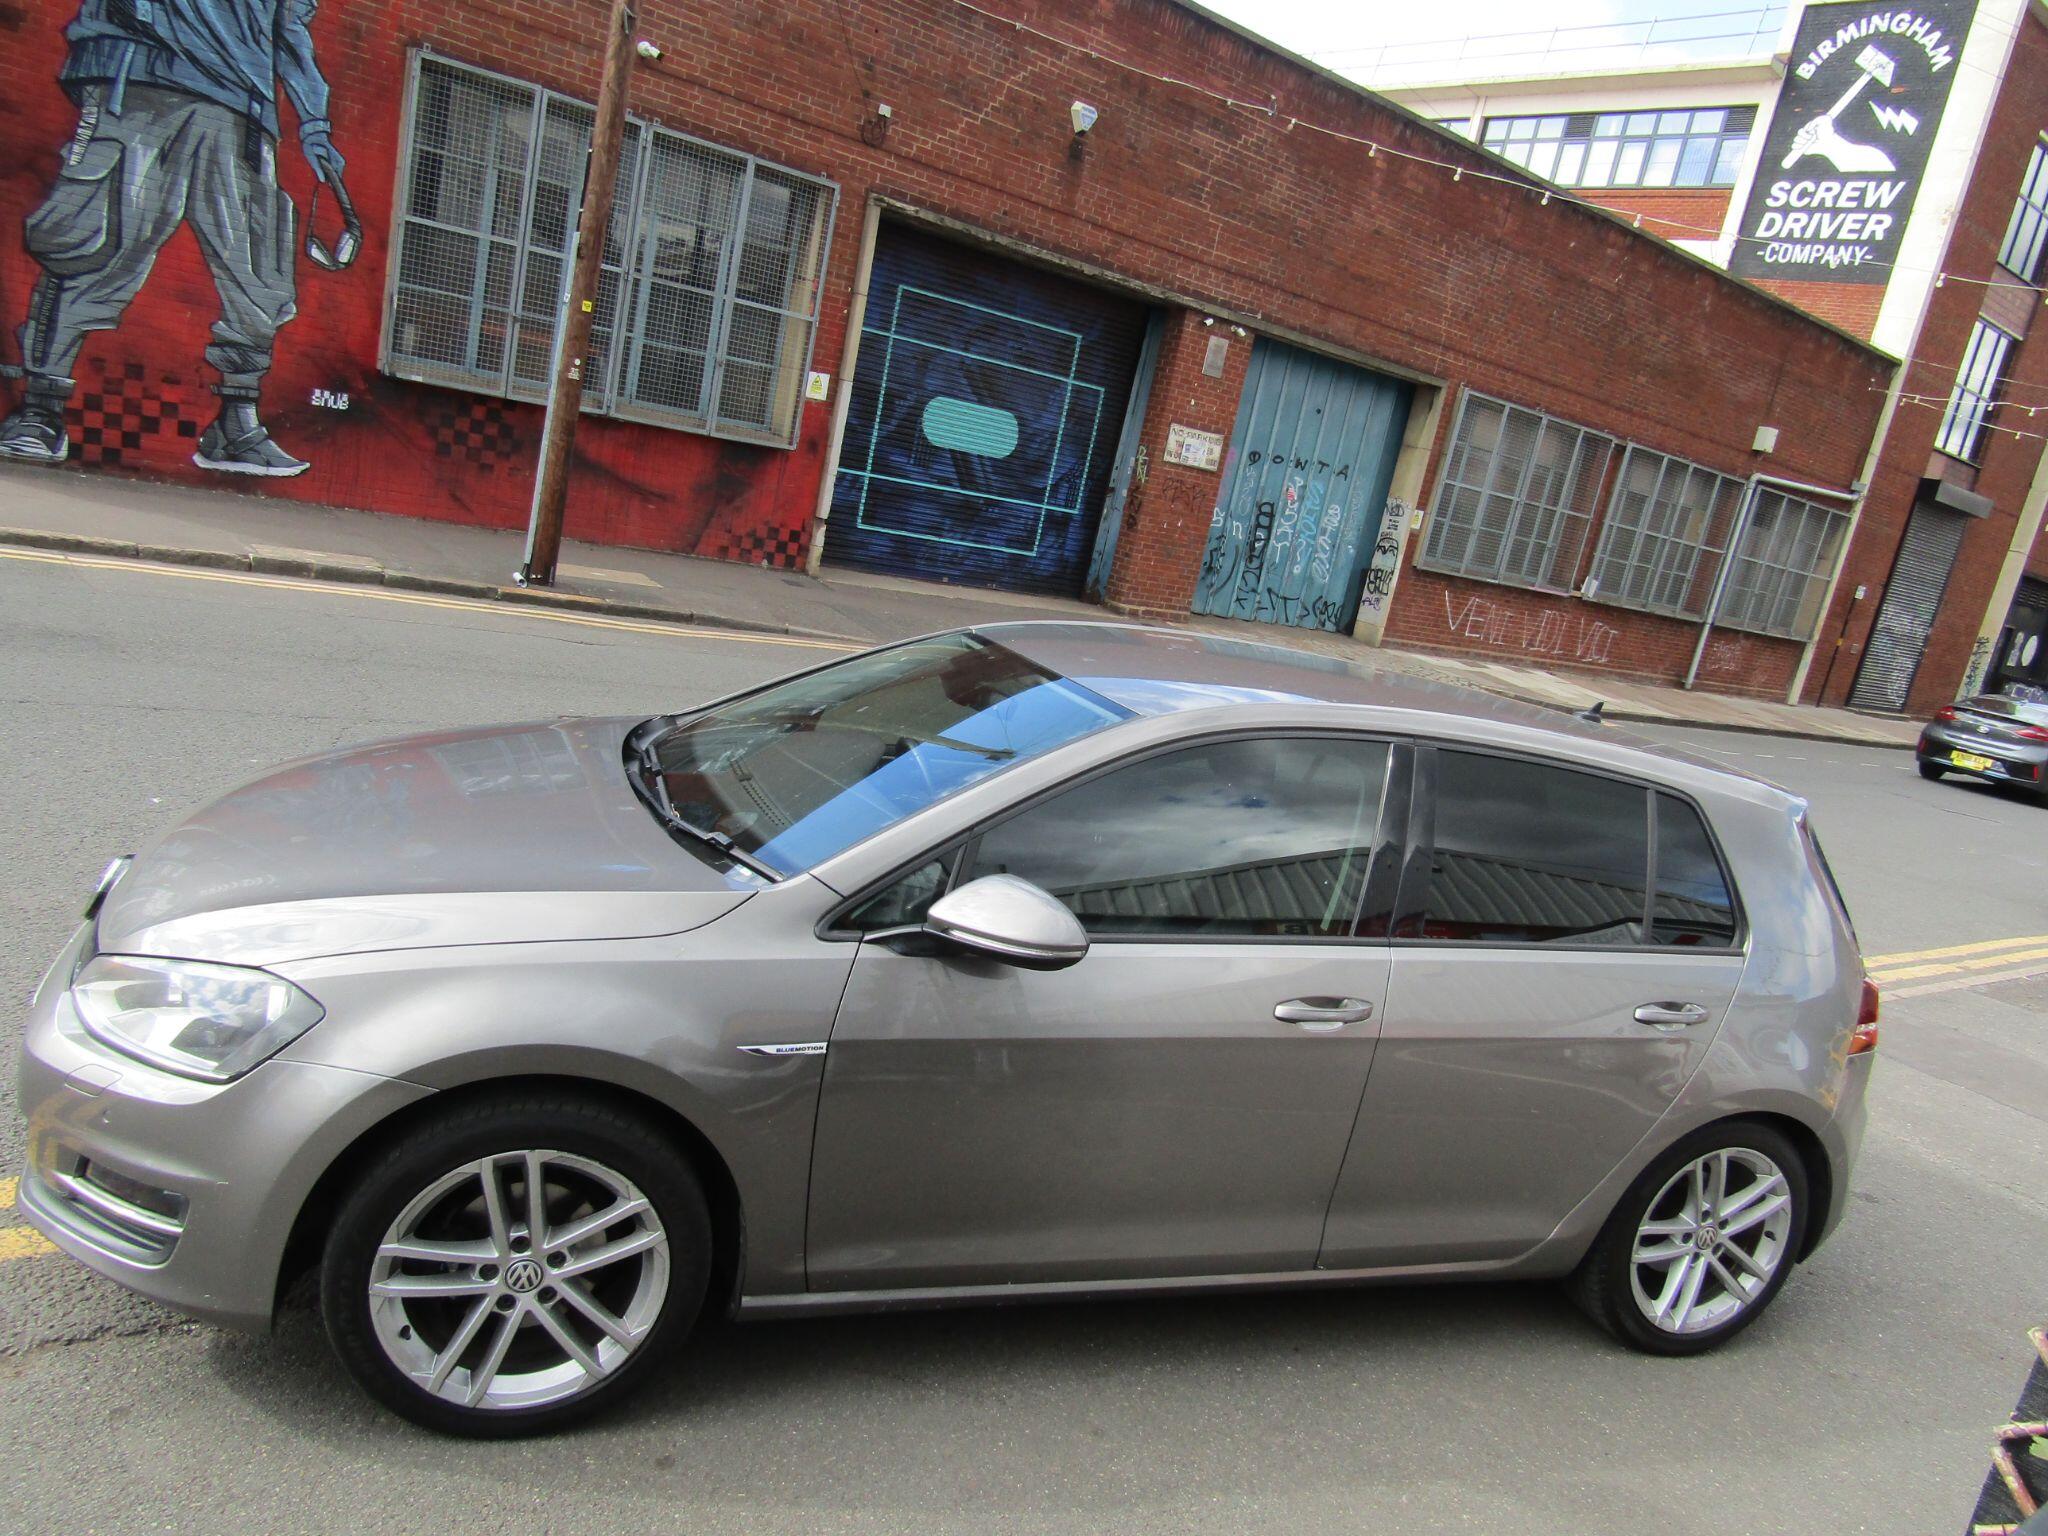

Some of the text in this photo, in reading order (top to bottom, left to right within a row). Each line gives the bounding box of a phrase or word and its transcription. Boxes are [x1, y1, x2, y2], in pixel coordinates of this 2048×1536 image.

[1795, 12, 1953, 80] BIRMINGHAM
[1765, 181, 1906, 209] SCREW
[1755, 212, 1893, 241] DRIVER
